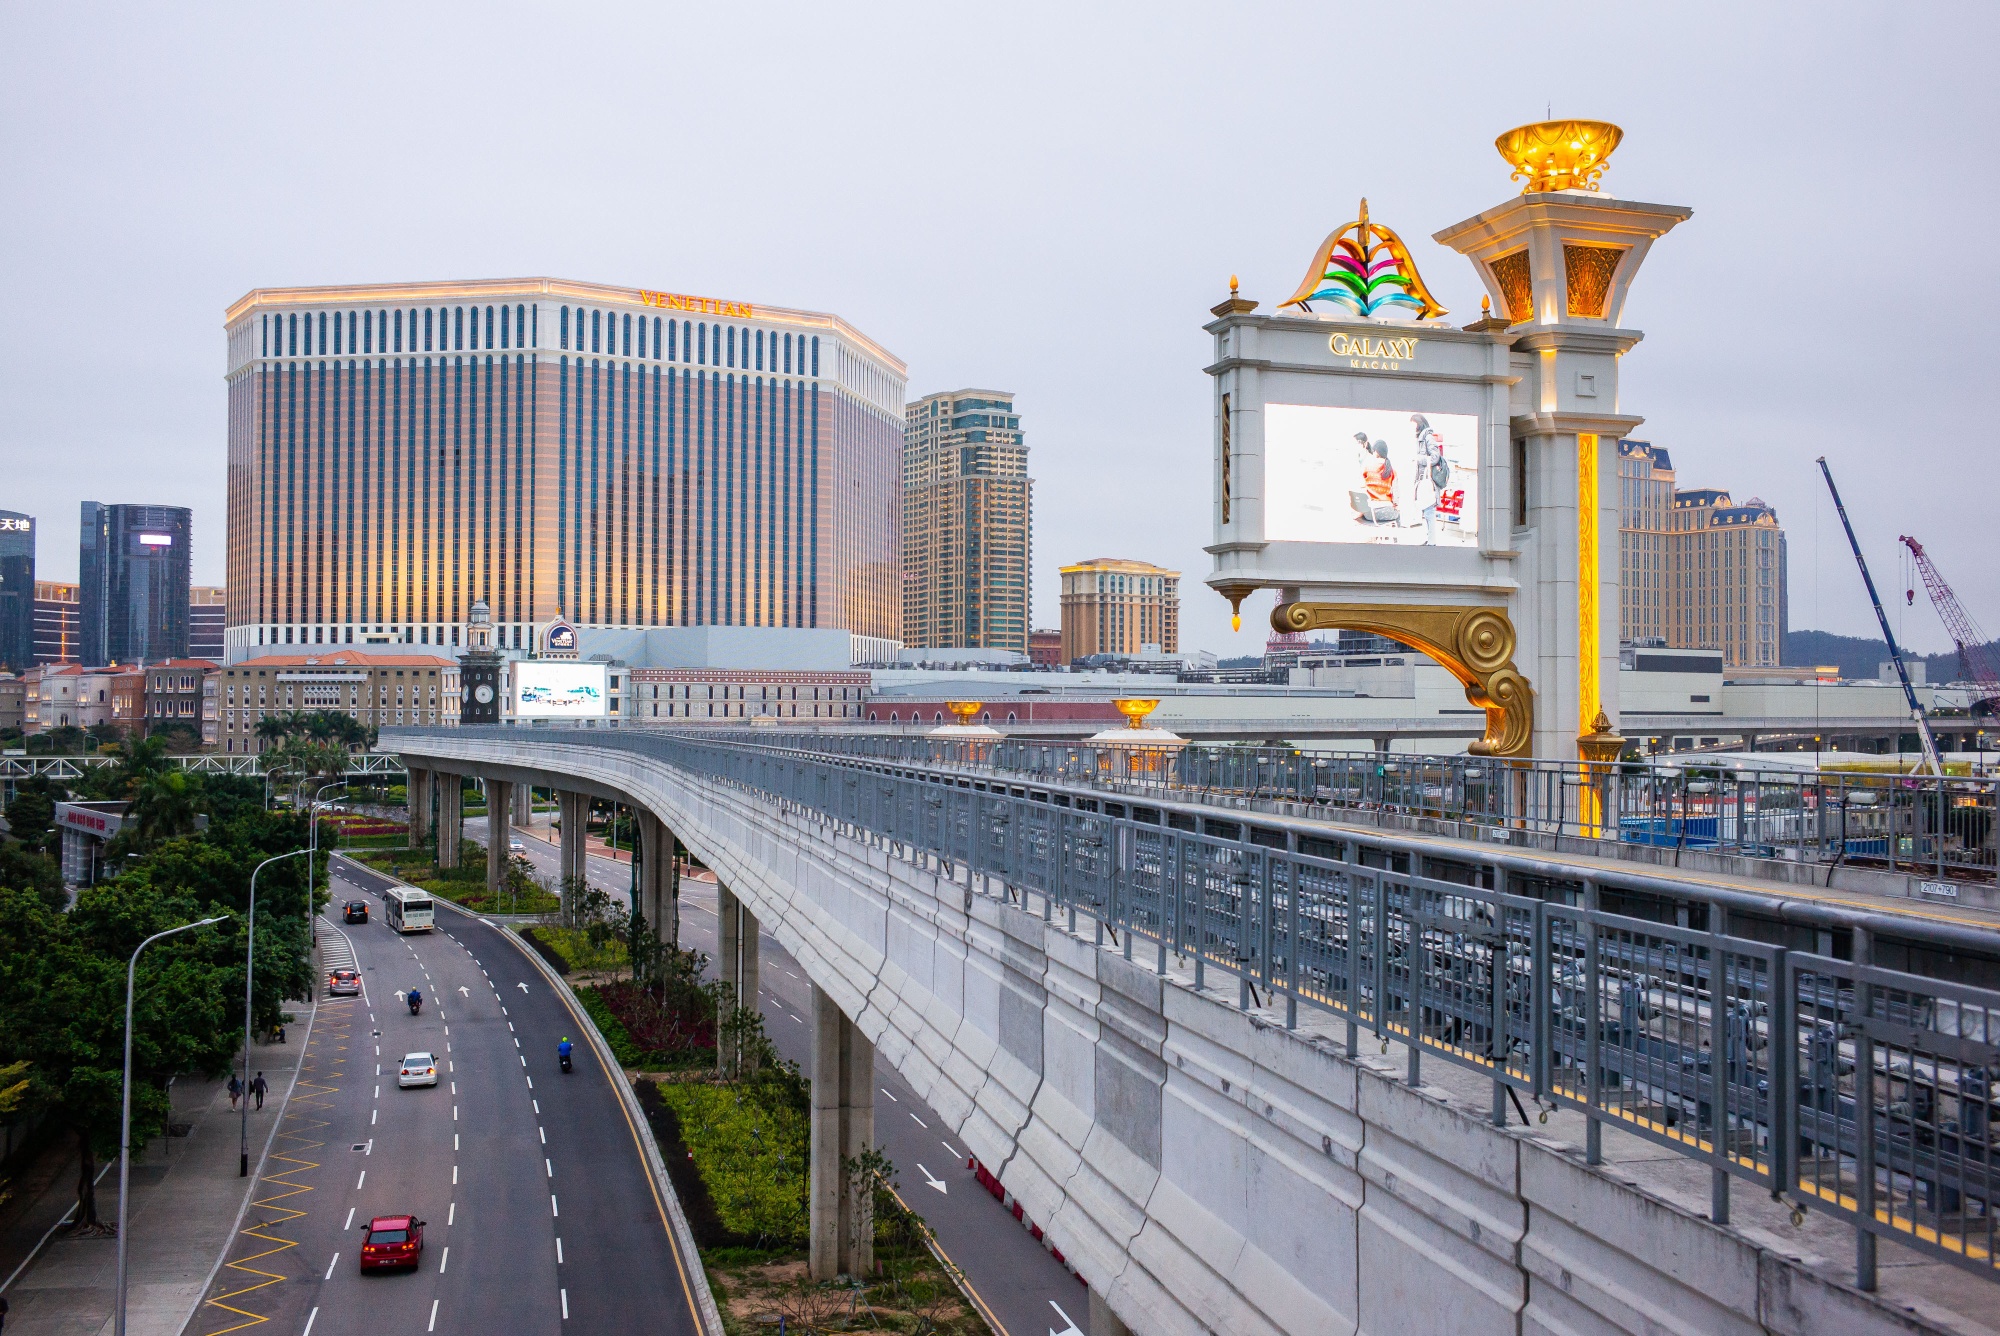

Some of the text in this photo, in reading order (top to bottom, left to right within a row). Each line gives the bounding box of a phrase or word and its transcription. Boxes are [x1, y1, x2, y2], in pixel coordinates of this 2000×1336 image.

[640, 289, 753, 318] VENETIAN
[1351, 359, 1399, 370] MACAU
[0, 518, 30, 531] 天地
